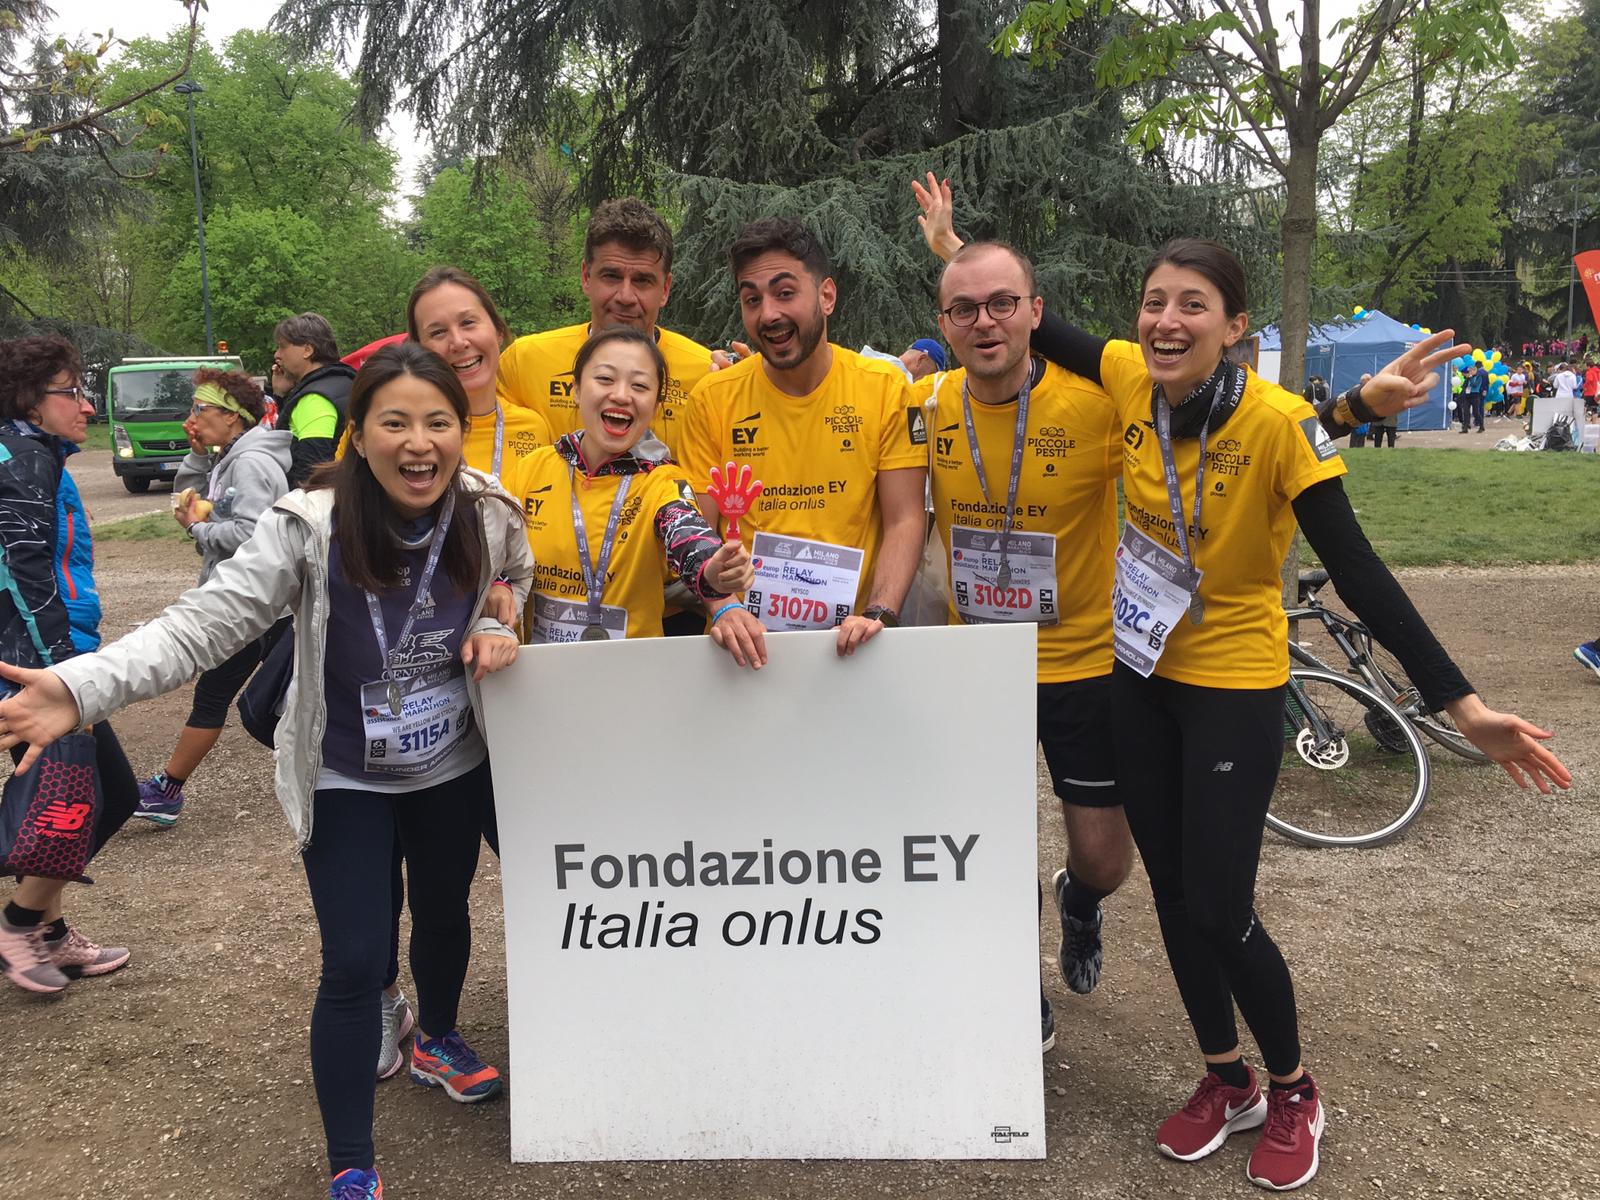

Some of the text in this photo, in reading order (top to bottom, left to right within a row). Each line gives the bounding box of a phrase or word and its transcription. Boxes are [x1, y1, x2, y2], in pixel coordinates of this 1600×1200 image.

[549, 381, 574, 396] EY
[1229, 367, 1245, 407] HUAWEI
[824, 415, 863, 426] PICCOLE
[831, 423, 859, 434] PESTI
[732, 427, 758, 444] EY
[1027, 437, 1076, 449] PICCOLE
[936, 436, 954, 456] EY
[1035, 447, 1067, 458] PESTI
[1205, 451, 1251, 466] PICCOLE
[1211, 462, 1240, 476] PESTI
[828, 480, 848, 494] EY
[525, 497, 544, 516] EY
[789, 498, 826, 511] onlus
[1027, 505, 1048, 517] EY
[953, 512, 1024, 530] Italia onus
[813, 549, 840, 560] MILANO
[763, 565, 780, 573] europ
[783, 566, 814, 577] RELAY
[1127, 562, 1150, 582] RELAY
[781, 573, 828, 587] MARATHON
[1125, 570, 1160, 598] MARATHON
[974, 583, 1033, 609] 3102D
[767, 593, 829, 624] 3107D
[549, 627, 579, 639] RELAY
[402, 695, 434, 712] RELAY
[404, 697, 450, 720] MARATHON
[400, 723, 413, 733] ARE
[412, 717, 431, 729] YELLOW
[431, 713, 441, 722] AND
[398, 718, 450, 754] 3115A
[554, 834, 981, 890] Fondazione EY
[560, 898, 884, 950] Italia onlus
